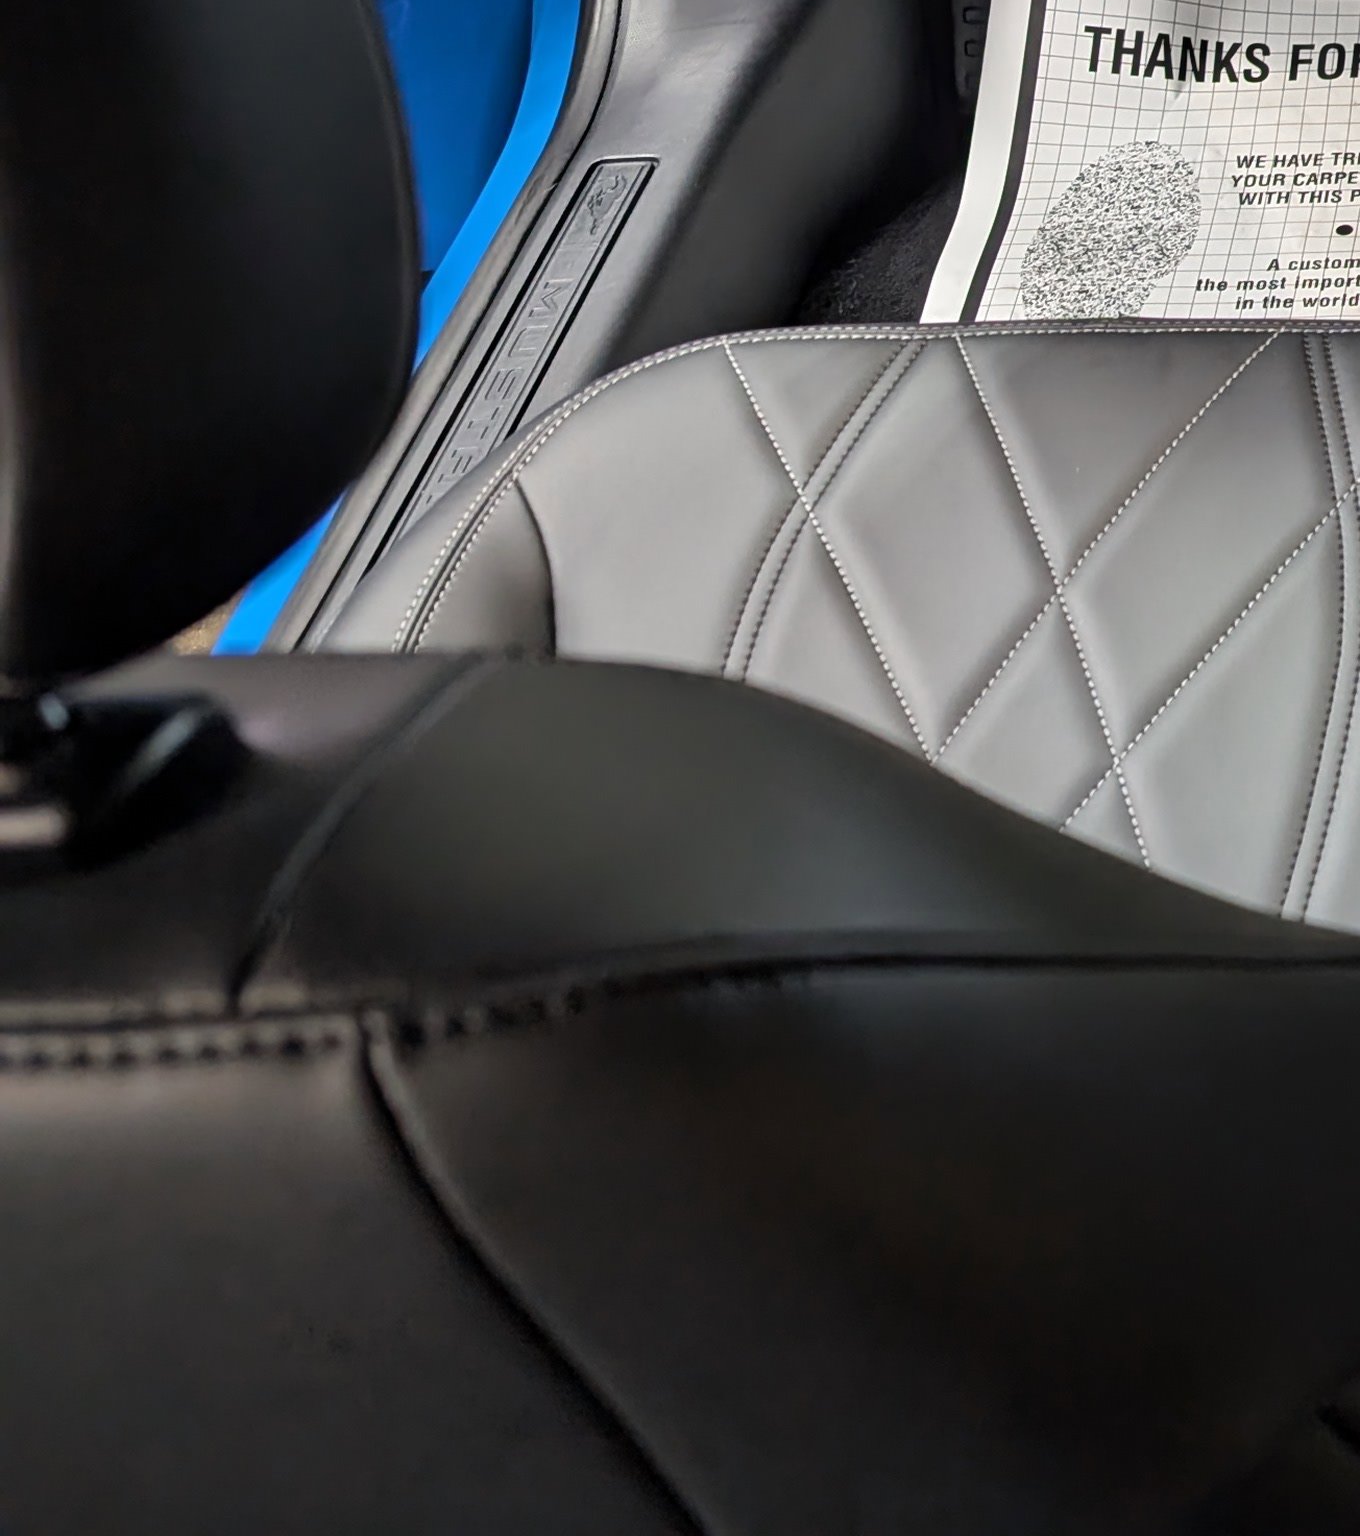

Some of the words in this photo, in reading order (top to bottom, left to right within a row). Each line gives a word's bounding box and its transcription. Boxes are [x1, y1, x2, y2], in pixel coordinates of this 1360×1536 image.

[1084, 25, 1271, 83] THANKS
[1236, 154, 1267, 169] WE
[1272, 152, 1325, 168] HAVE
[1231, 173, 1286, 188] YOUR
[1238, 191, 1290, 205] WITH
[1298, 190, 1342, 204] THIS
[1266, 258, 1281, 271] A
[1195, 278, 1228, 292] the
[1236, 277, 1287, 291] most
[1235, 296, 1254, 310] in
[1262, 294, 1294, 309] the
[1302, 292, 1360, 308] world
[426, 278, 577, 505] MUSTA
